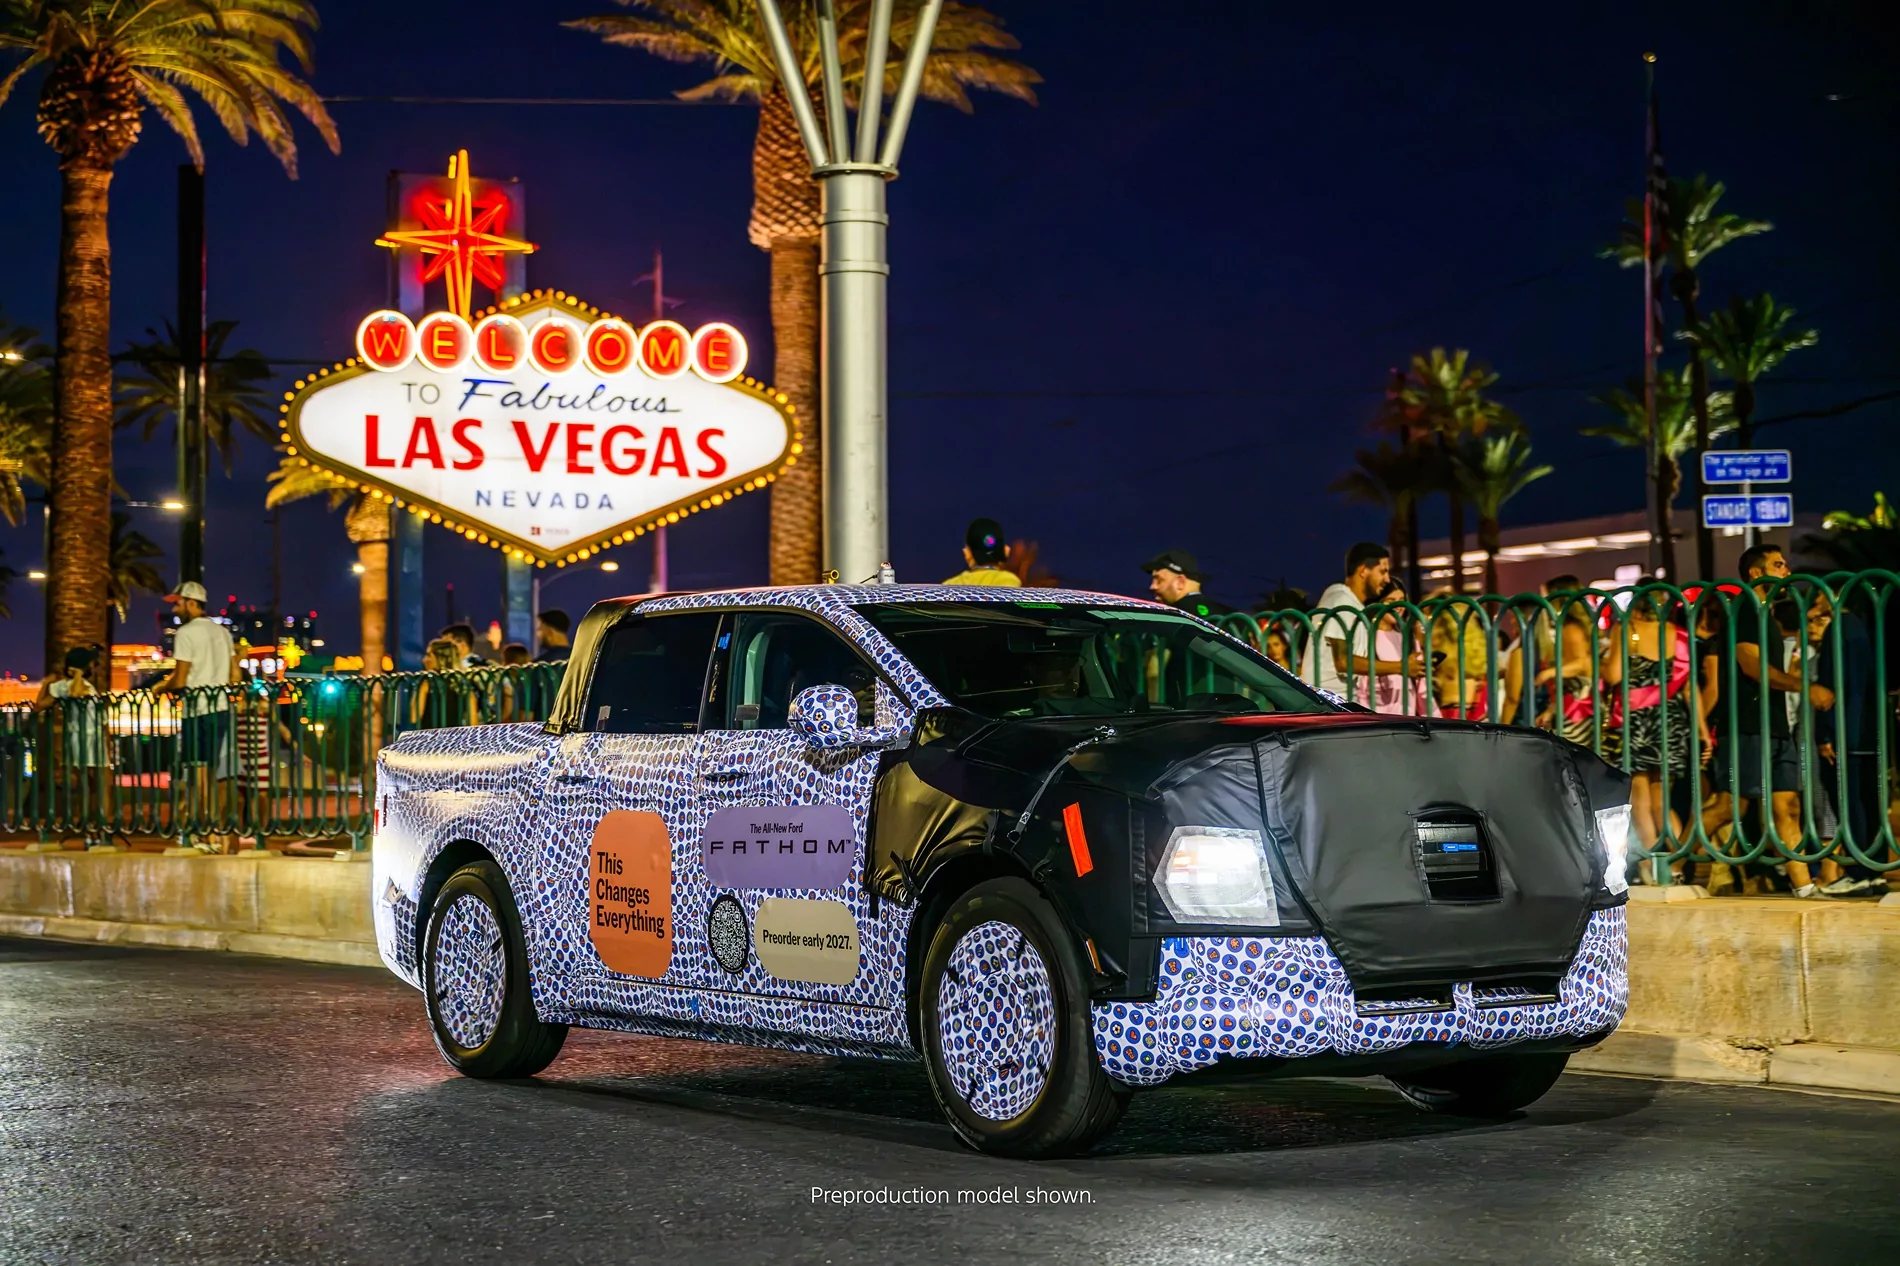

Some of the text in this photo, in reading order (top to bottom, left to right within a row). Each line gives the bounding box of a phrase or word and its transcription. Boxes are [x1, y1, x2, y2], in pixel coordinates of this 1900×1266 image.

[369, 325, 731, 371] WELCOME
[401, 378, 681, 413] TO Fabulous
[365, 414, 728, 479] LAS VEGAS
[476, 490, 613, 510] NEVADA
[750, 822, 804, 834] The All-New Ford
[597, 851, 623, 875] This
[596, 878, 650, 908] Changes
[596, 904, 665, 939] Everything
[762, 929, 853, 951] Preorder early 2027.
